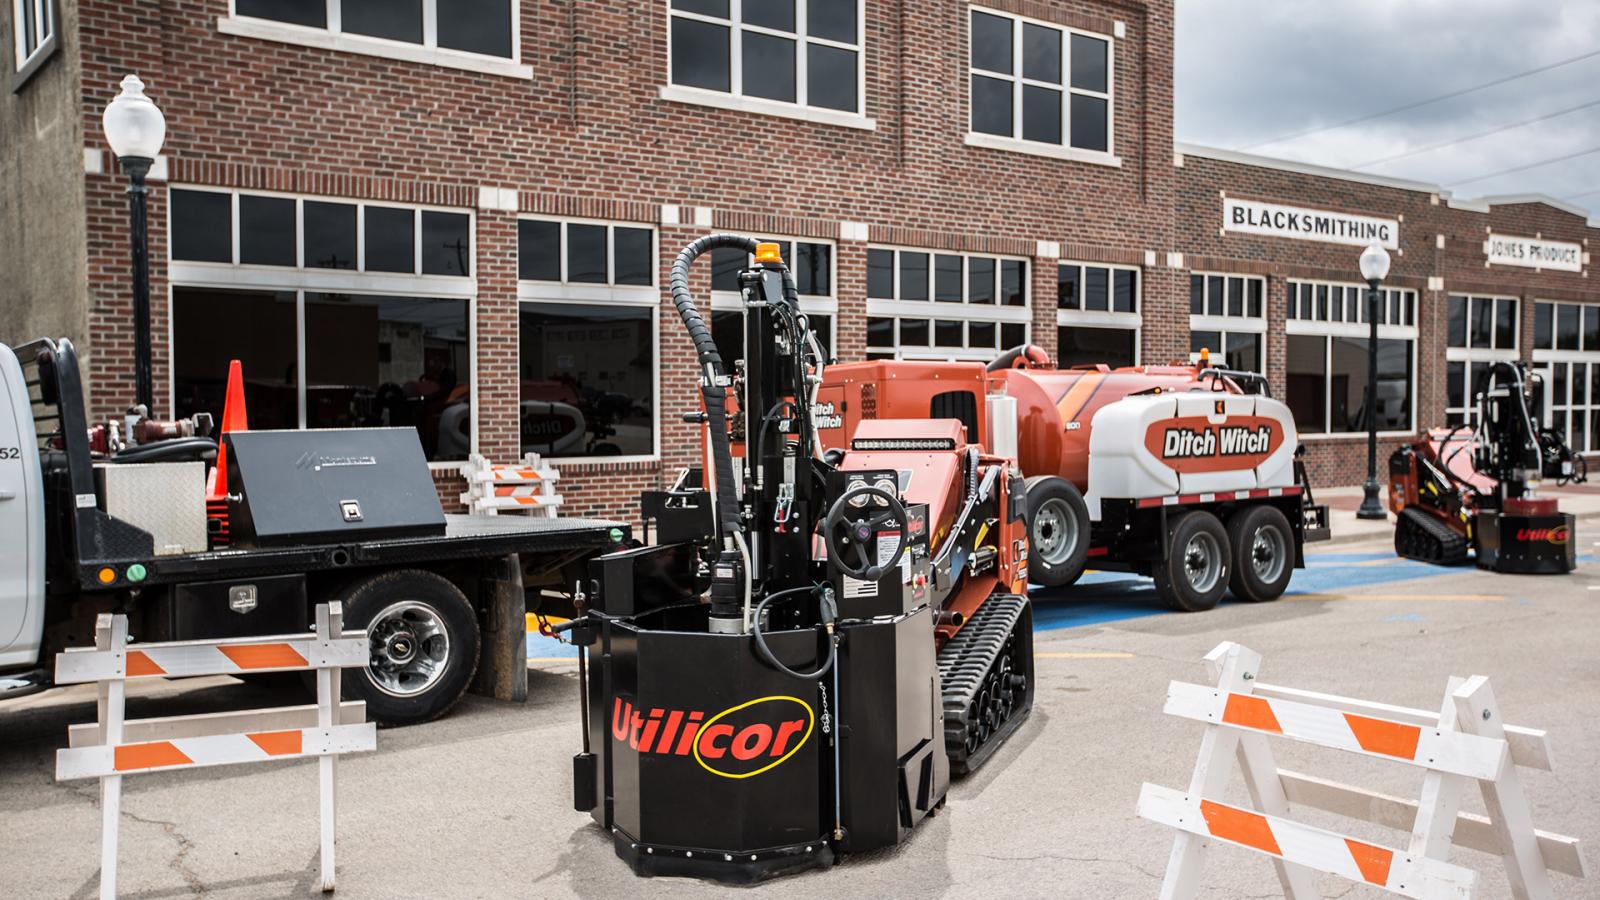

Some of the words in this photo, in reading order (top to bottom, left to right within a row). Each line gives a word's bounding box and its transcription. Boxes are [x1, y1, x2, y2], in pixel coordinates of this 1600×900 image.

[1232, 206, 1389, 241] BLACKSMITHING
[1491, 241, 1524, 258] JONES
[1530, 245, 1576, 264] PRODUCE
[815, 402, 834, 415] itch
[1163, 428, 1216, 458] Ditch
[1220, 426, 1270, 454] Witch
[612, 696, 805, 761] Utilicor
